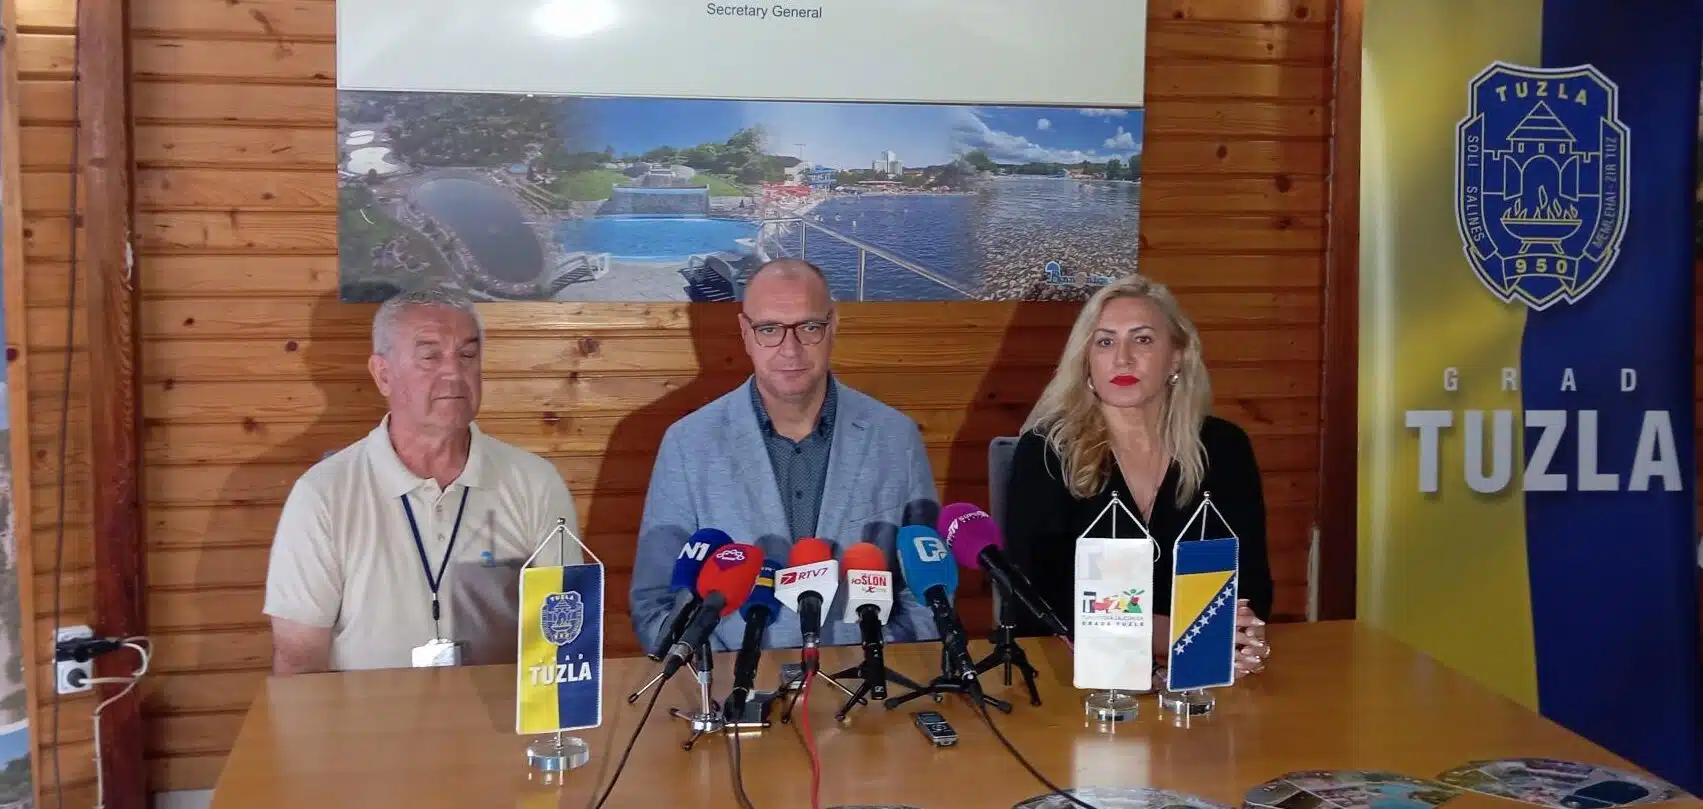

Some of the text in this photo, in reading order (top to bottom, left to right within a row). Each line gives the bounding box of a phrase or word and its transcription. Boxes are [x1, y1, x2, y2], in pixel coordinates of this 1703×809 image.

[707, 3, 823, 19] Secretary General
[1494, 81, 1587, 106] TUZLA
[1466, 135, 1485, 243] SOLI SALINES
[1515, 258, 1568, 273] 950
[1443, 366, 1638, 393] GRAD
[1404, 409, 1684, 493] TUZLA
[676, 541, 711, 561] N1
[797, 567, 828, 580] RTV7
[529, 662, 591, 685] TUZLA
